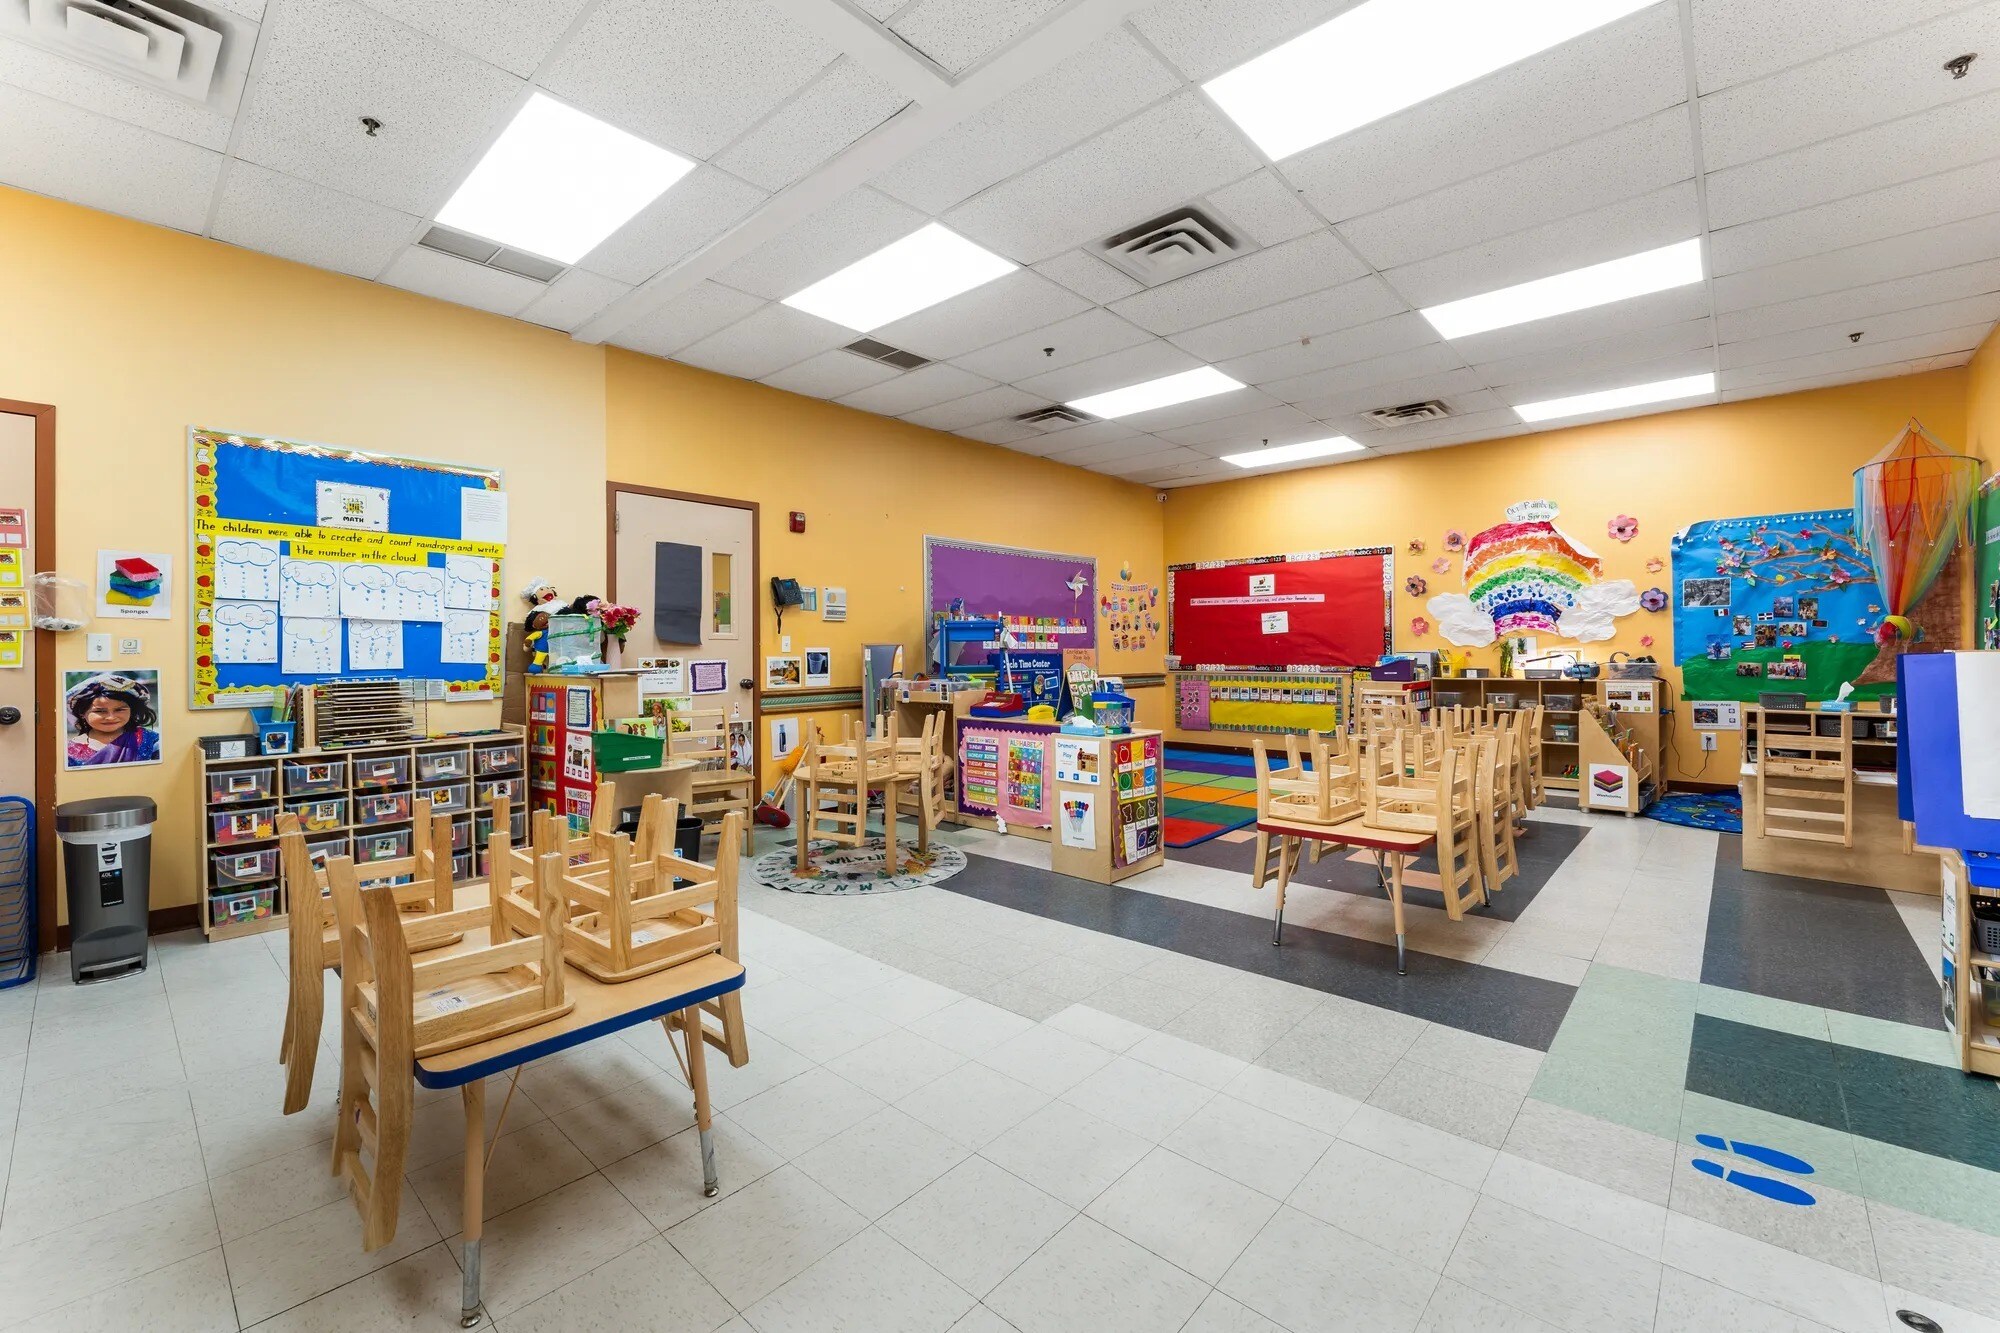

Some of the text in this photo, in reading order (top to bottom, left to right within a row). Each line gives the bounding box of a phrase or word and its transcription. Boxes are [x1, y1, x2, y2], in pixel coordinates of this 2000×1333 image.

[196, 519, 499, 554] The children were able to create and count raindrops and write
[296, 545, 314, 555] the
[318, 548, 357, 558] number
[361, 551, 370, 559] in
[372, 550, 387, 560] the
[1019, 659, 1032, 668] Time
[1032, 659, 1051, 668] Center
[1010, 738, 1037, 748] ALPHABET
[1062, 751, 1072, 759] Play
[567, 789, 588, 800] NUMBERS
